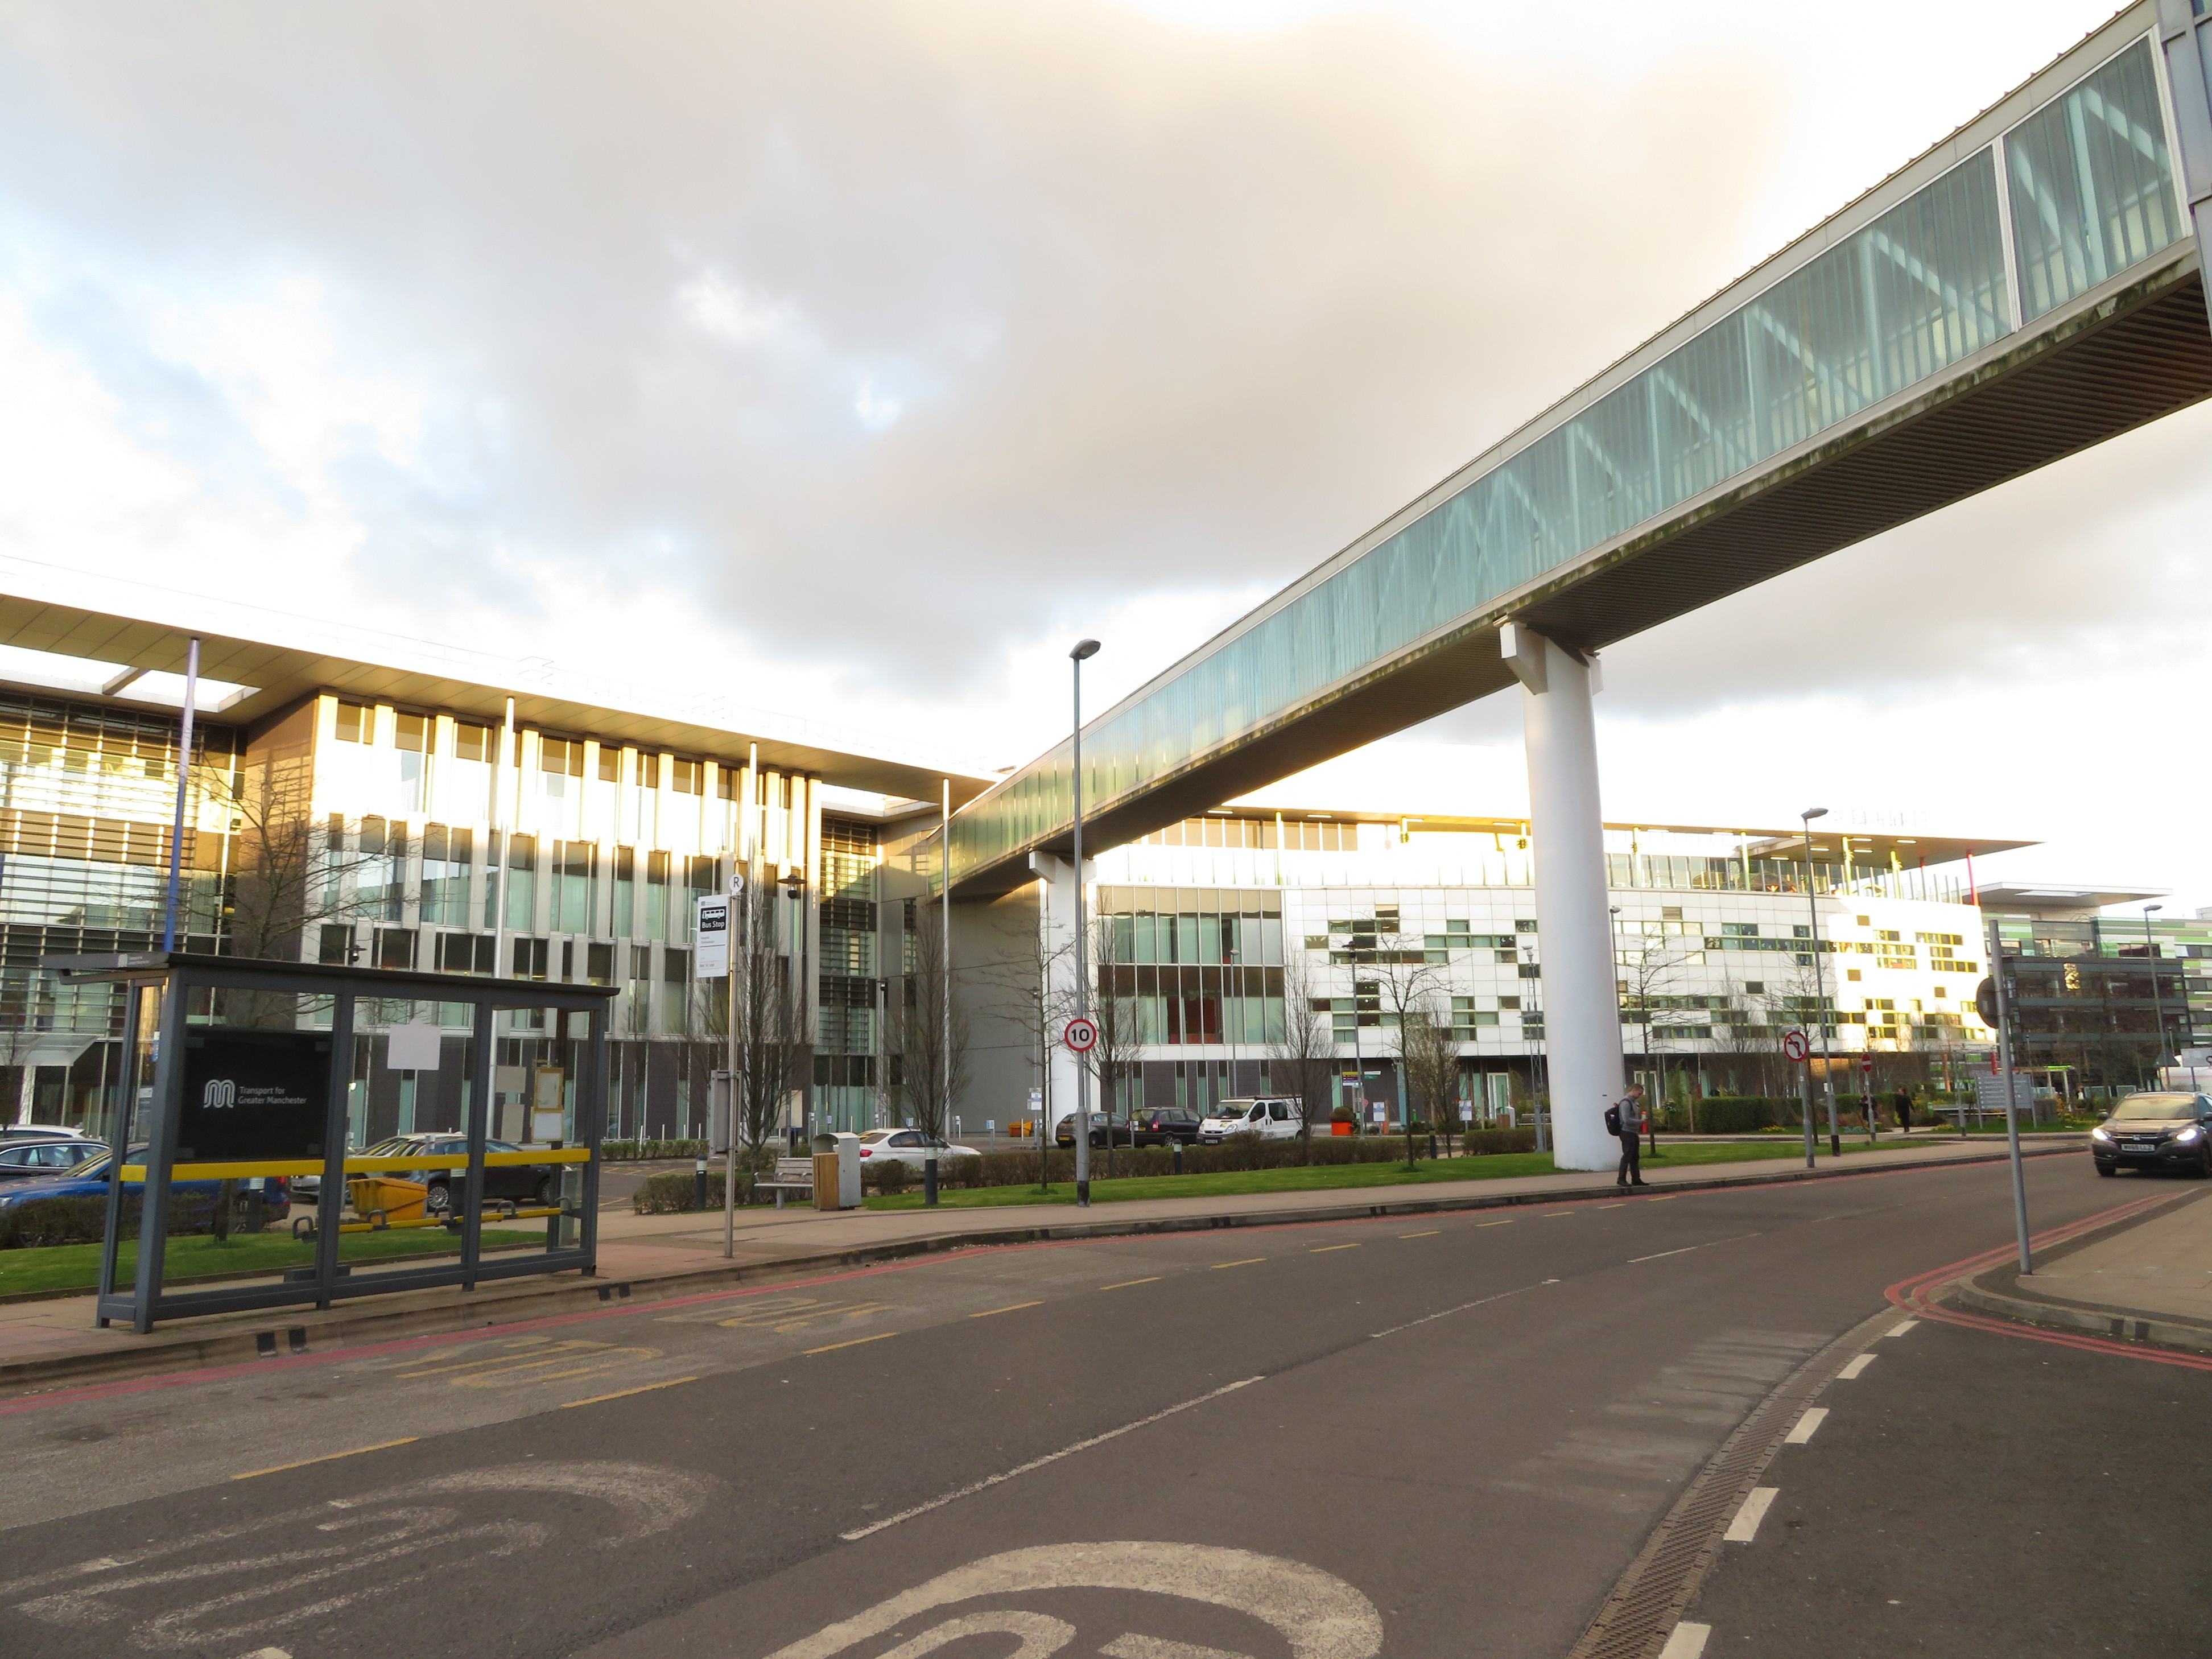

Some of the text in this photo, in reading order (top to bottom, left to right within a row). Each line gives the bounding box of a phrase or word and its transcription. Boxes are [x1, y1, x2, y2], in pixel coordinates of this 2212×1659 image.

[733, 877, 740, 888] R
[1071, 1028, 1090, 1042] 10
[240, 1086, 274, 1096] Transport
[238, 1096, 308, 1104] Greater Manchester
[653, 1296, 930, 1336] BUS
